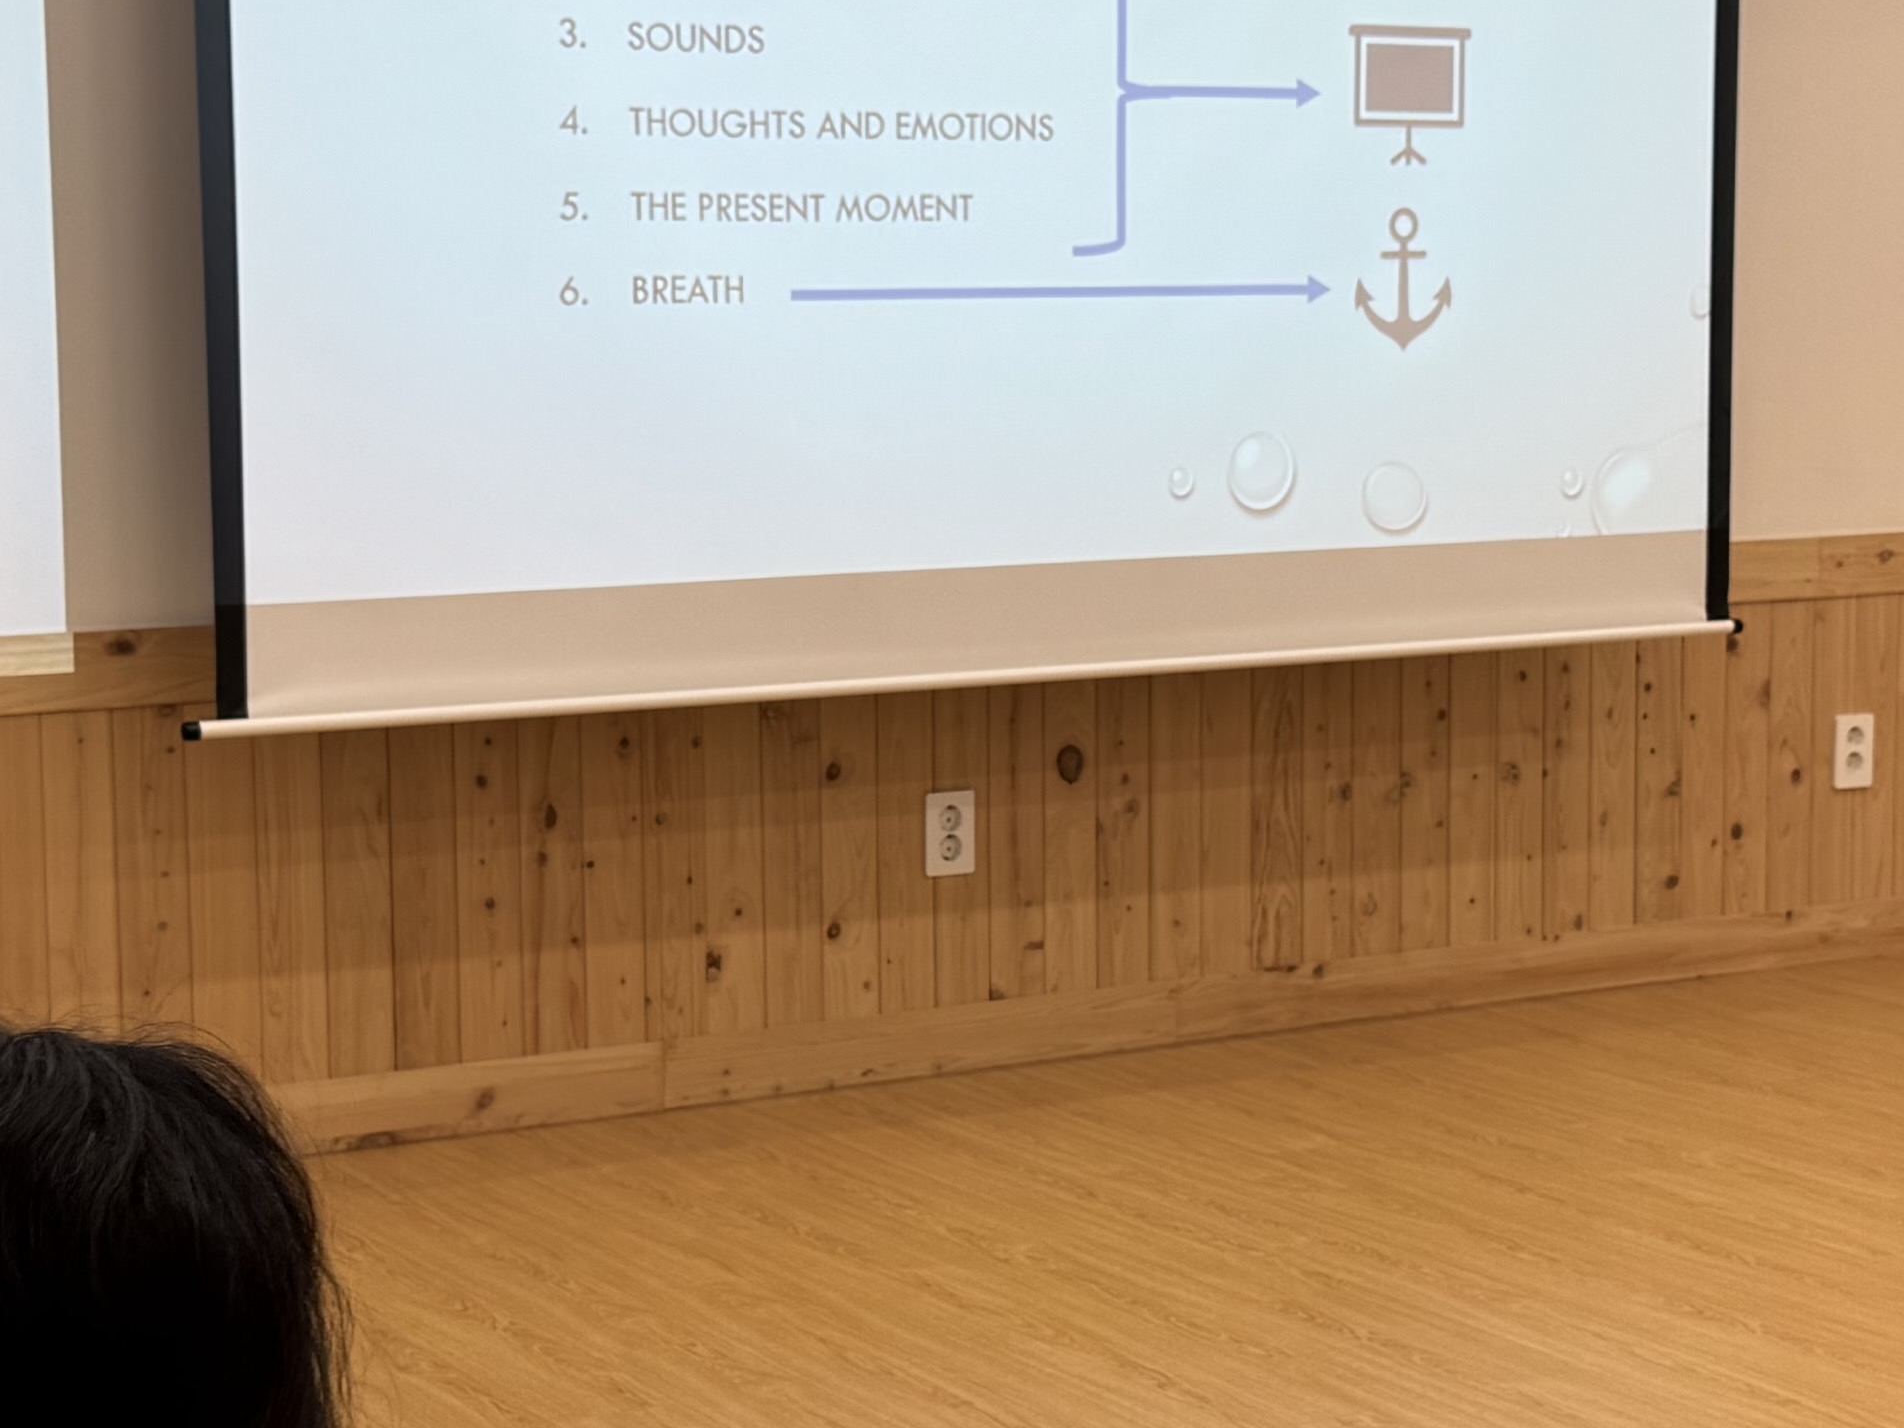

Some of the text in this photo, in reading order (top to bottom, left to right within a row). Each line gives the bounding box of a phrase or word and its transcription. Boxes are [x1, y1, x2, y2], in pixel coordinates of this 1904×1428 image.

[559, 17, 765, 54] 3. SOUNDS
[559, 105, 1054, 142] 4. THOUGHTS AND EMOTIONS
[560, 191, 974, 222] 5. THE PRESENT MOMENT
[559, 275, 744, 306] 6. BREATH
